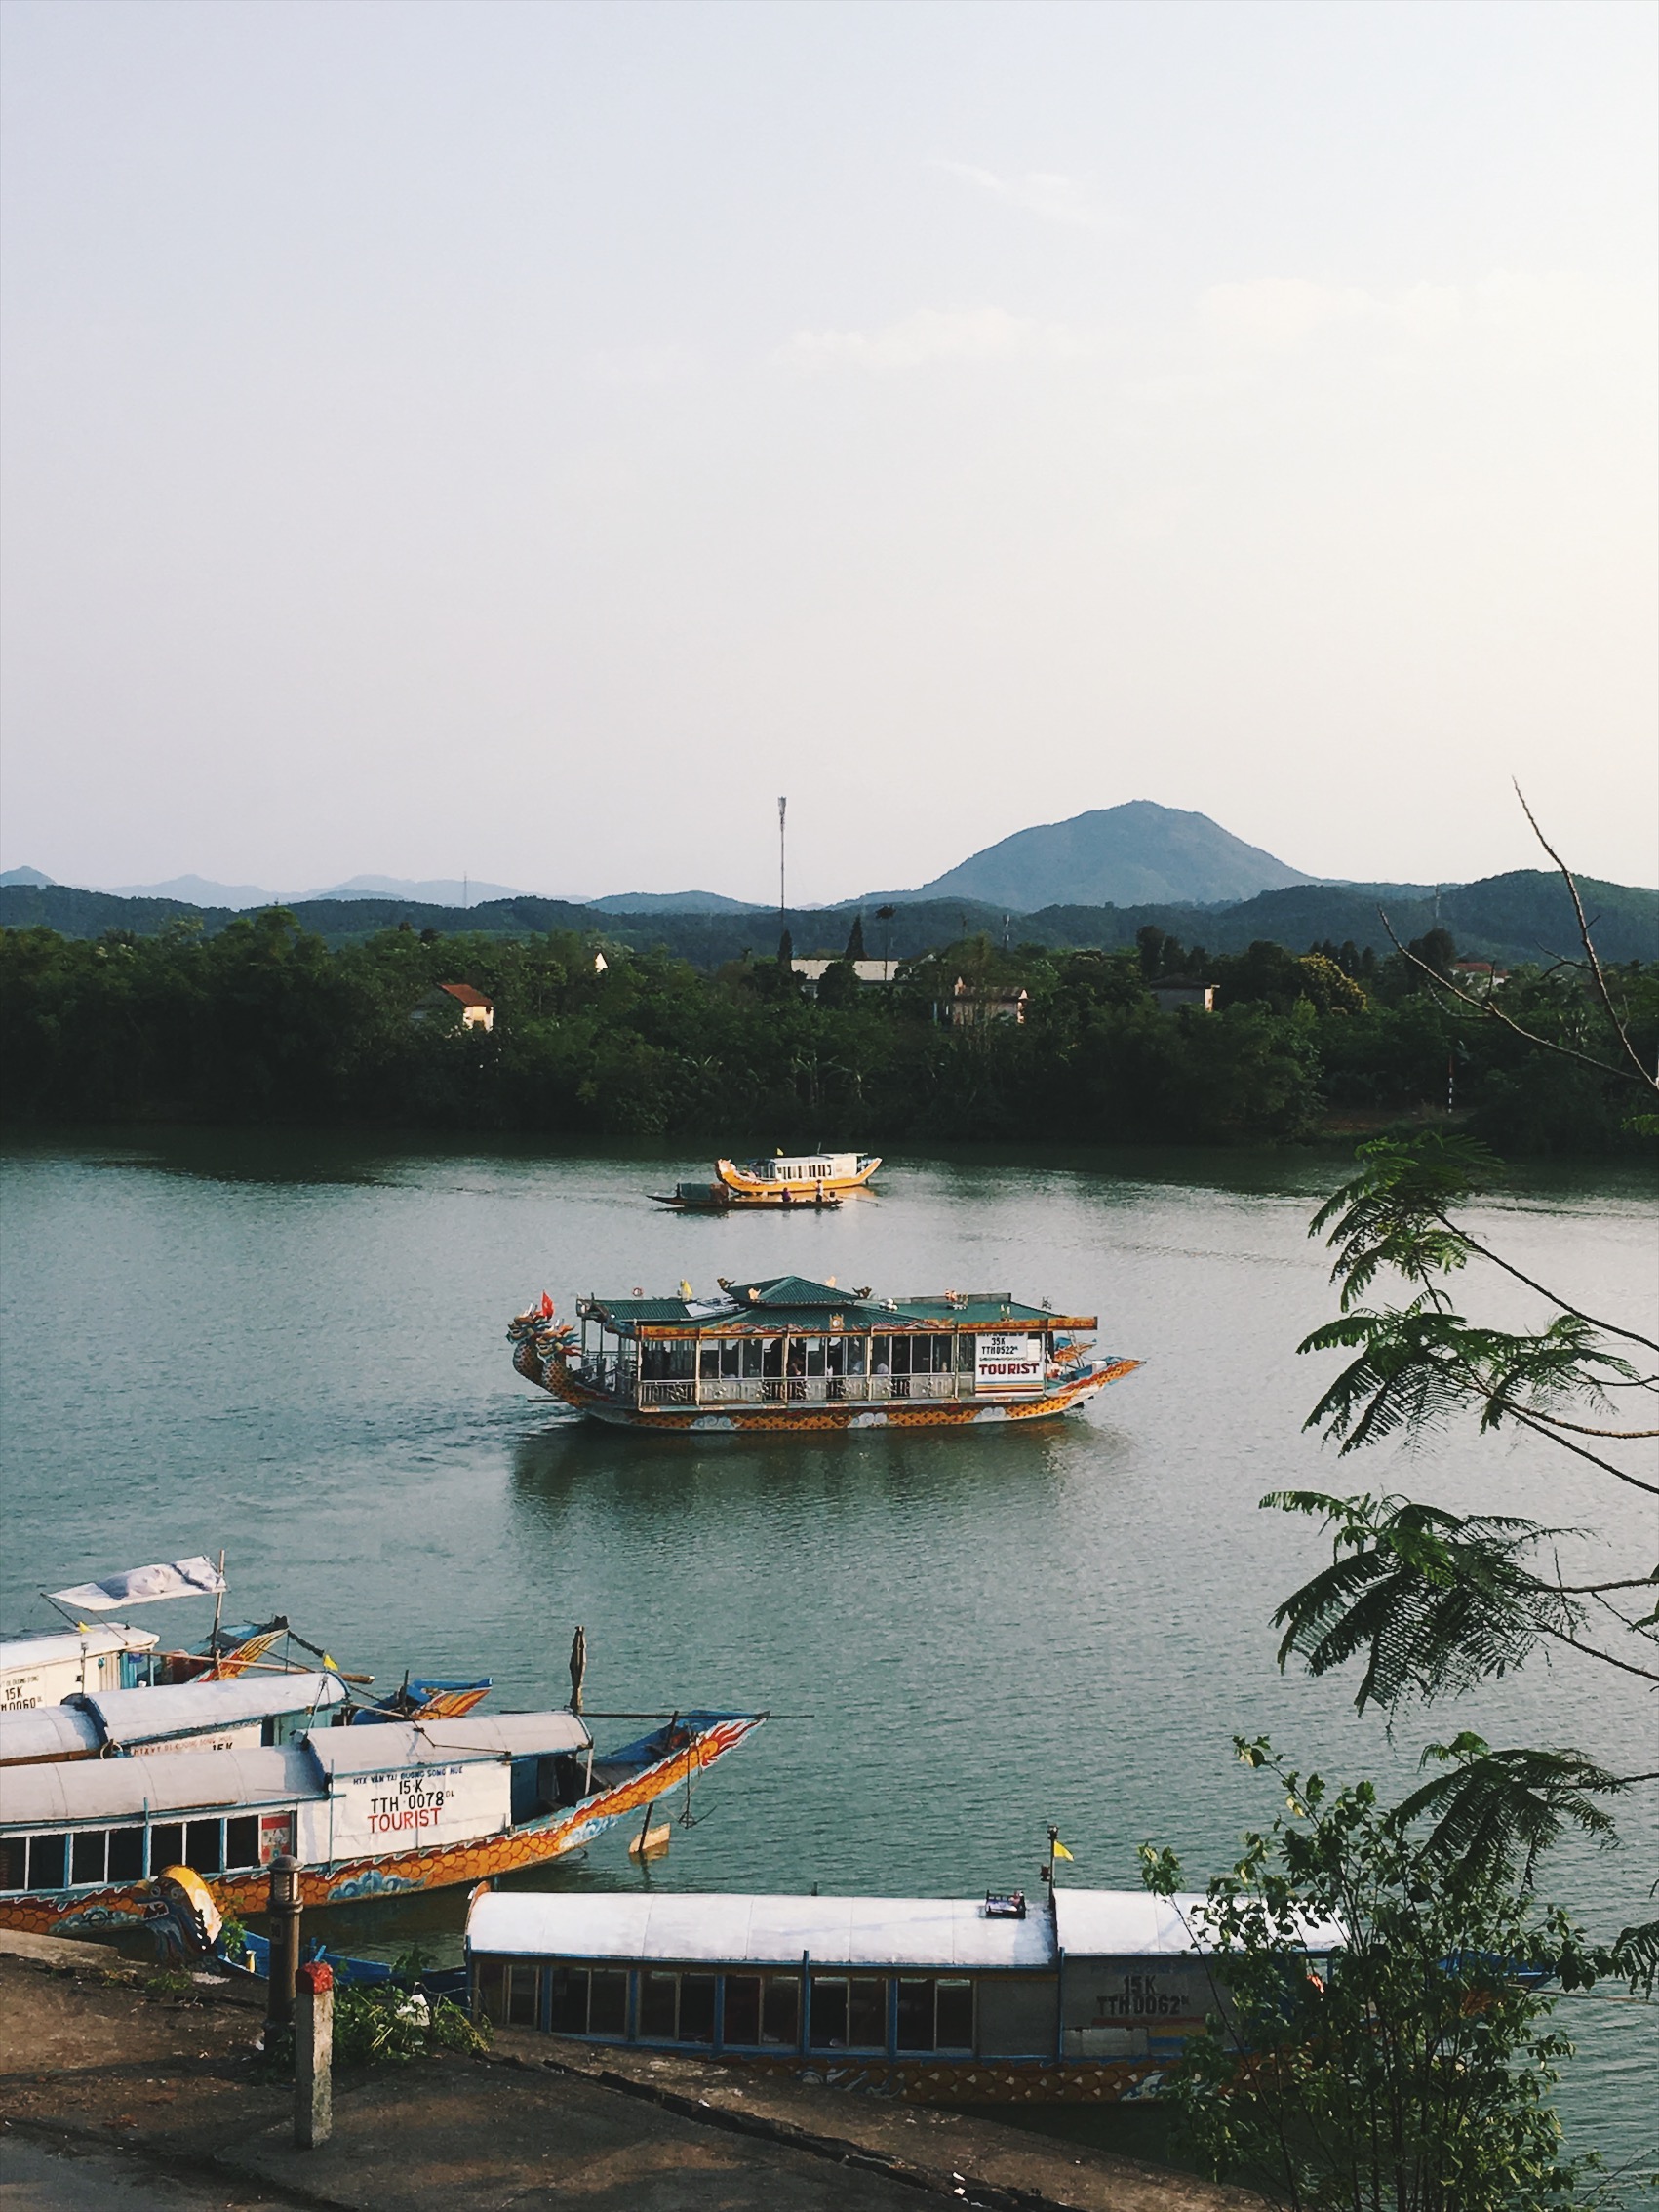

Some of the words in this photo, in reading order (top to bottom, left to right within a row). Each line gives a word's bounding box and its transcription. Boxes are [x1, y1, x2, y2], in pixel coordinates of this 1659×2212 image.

[978, 1363, 1040, 1375] TOURIST
[371, 1796, 399, 1813] TTH
[367, 1807, 442, 1834] TOURIST
